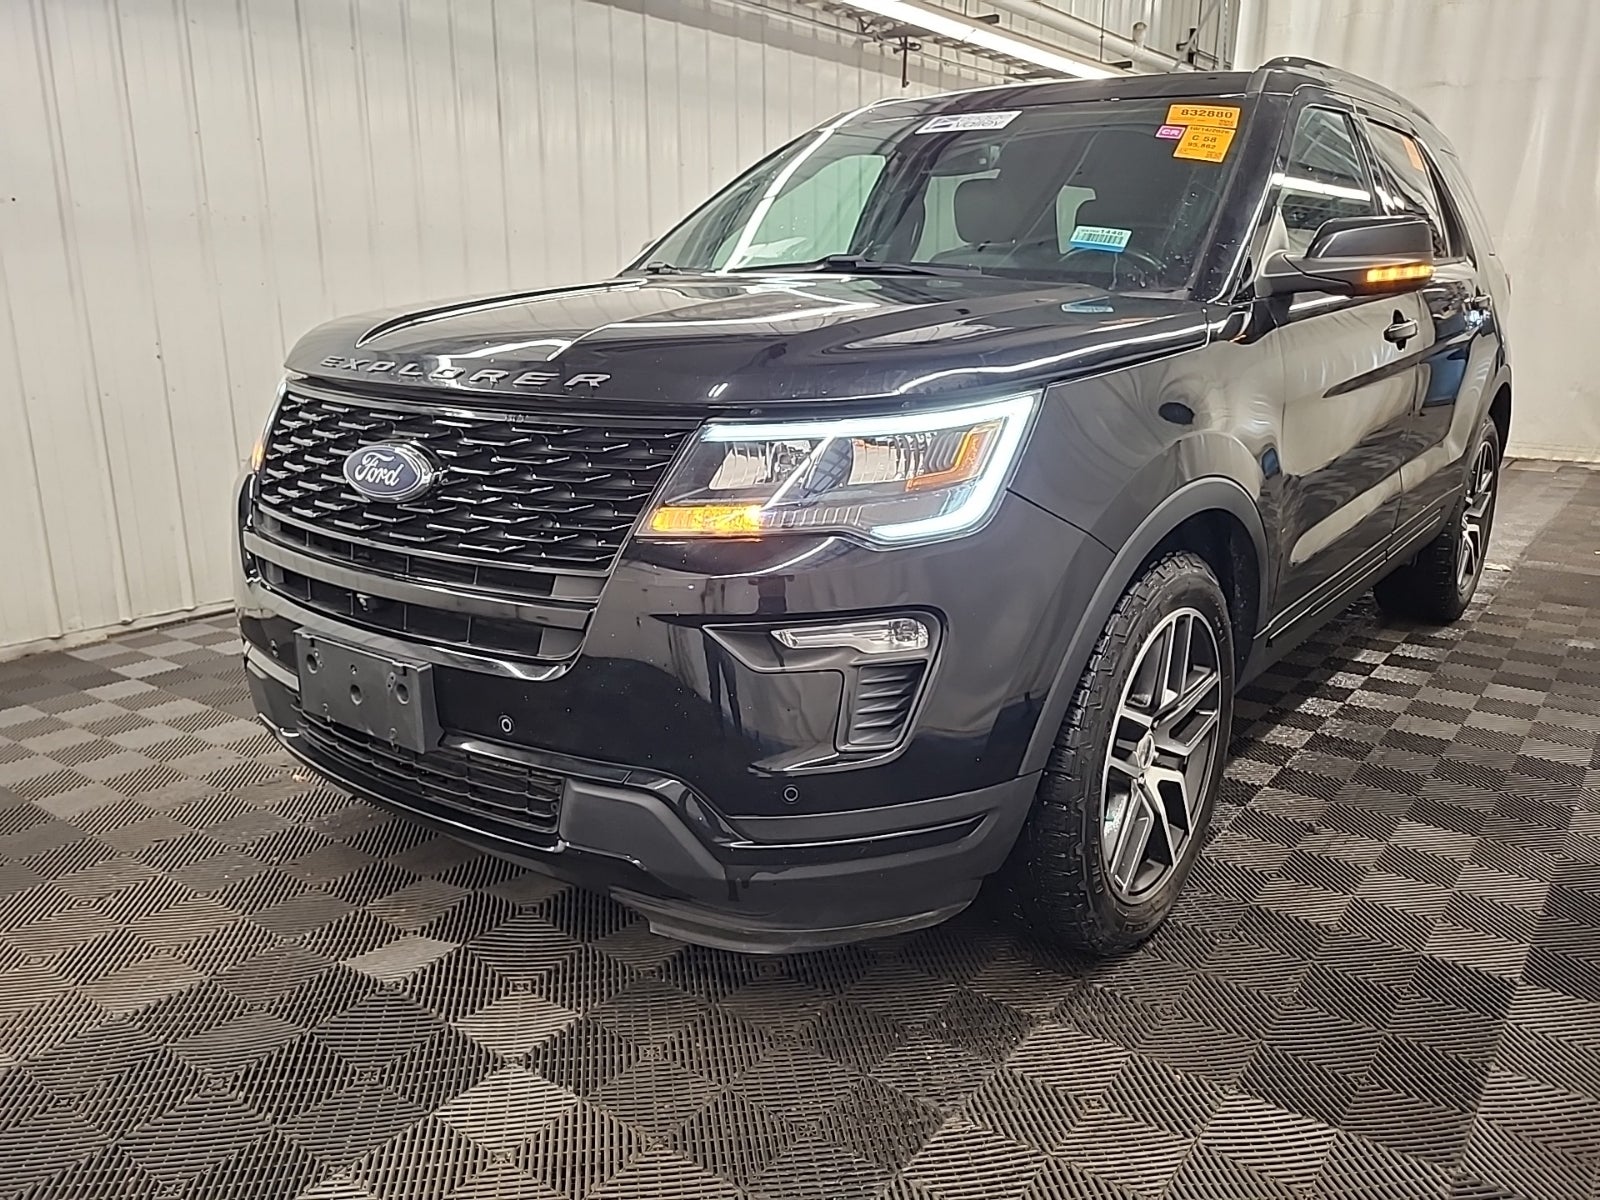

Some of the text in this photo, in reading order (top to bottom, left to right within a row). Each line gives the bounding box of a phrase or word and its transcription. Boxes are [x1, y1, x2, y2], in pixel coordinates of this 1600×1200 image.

[1181, 109, 1233, 118] 832880
[320, 355, 612, 388] EXPLORER
[354, 451, 404, 487] Ford
